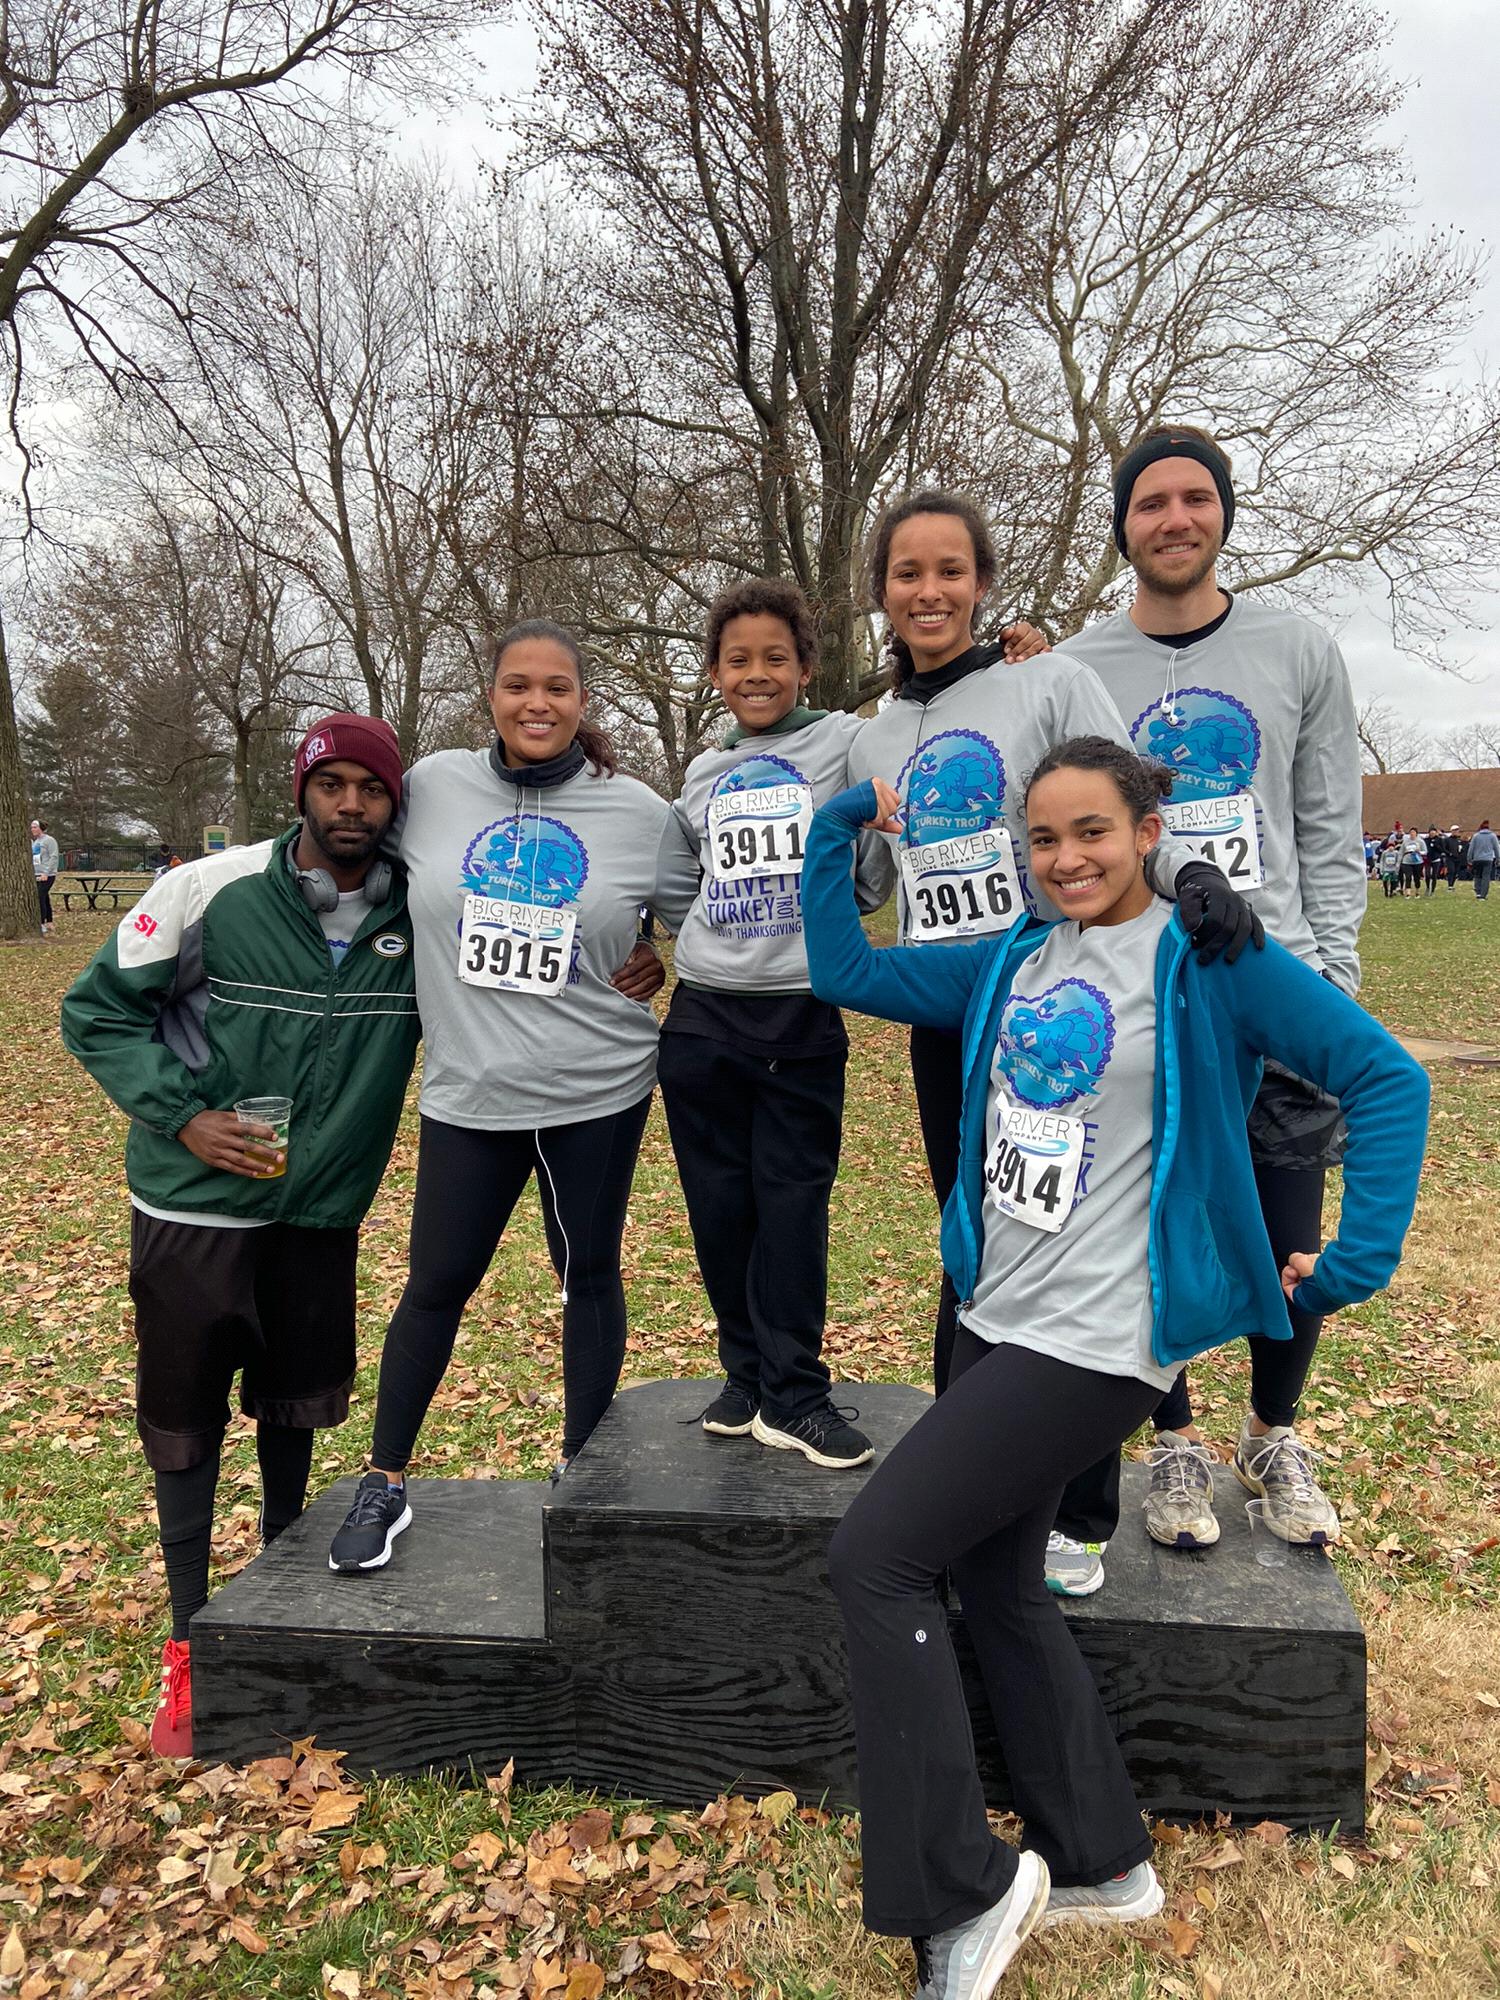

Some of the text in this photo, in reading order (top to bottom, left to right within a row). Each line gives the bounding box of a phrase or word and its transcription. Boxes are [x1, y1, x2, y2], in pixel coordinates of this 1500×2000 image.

[1204, 778, 1232, 791] TROT
[714, 786, 799, 814] BIG RIVER
[716, 804, 778, 819] RUNNING COMPANY
[1180, 799, 1240, 822] RIVER
[915, 815, 981, 829] TURKEY TROT
[1181, 818, 1218, 834] COMPANY
[718, 822, 804, 870] 3911
[909, 847, 935, 868] BIG
[938, 833, 997, 861] RIVER
[1199, 836, 1251, 878] 12
[941, 855, 975, 868] COMPANY
[473, 898, 564, 927] BIG RIVER
[707, 896, 776, 926] TURKEY
[776, 894, 795, 920] TROT
[916, 872, 1013, 929] 3916
[714, 920, 802, 940] 2019 THANKSGIVING
[466, 934, 563, 983] 3915
[1012, 1056, 1070, 1094] TURKEY TROT
[1006, 1110, 1070, 1140] RIVER
[1008, 1130, 1042, 1142] OMPANY
[986, 1138, 1063, 1214] 3914
